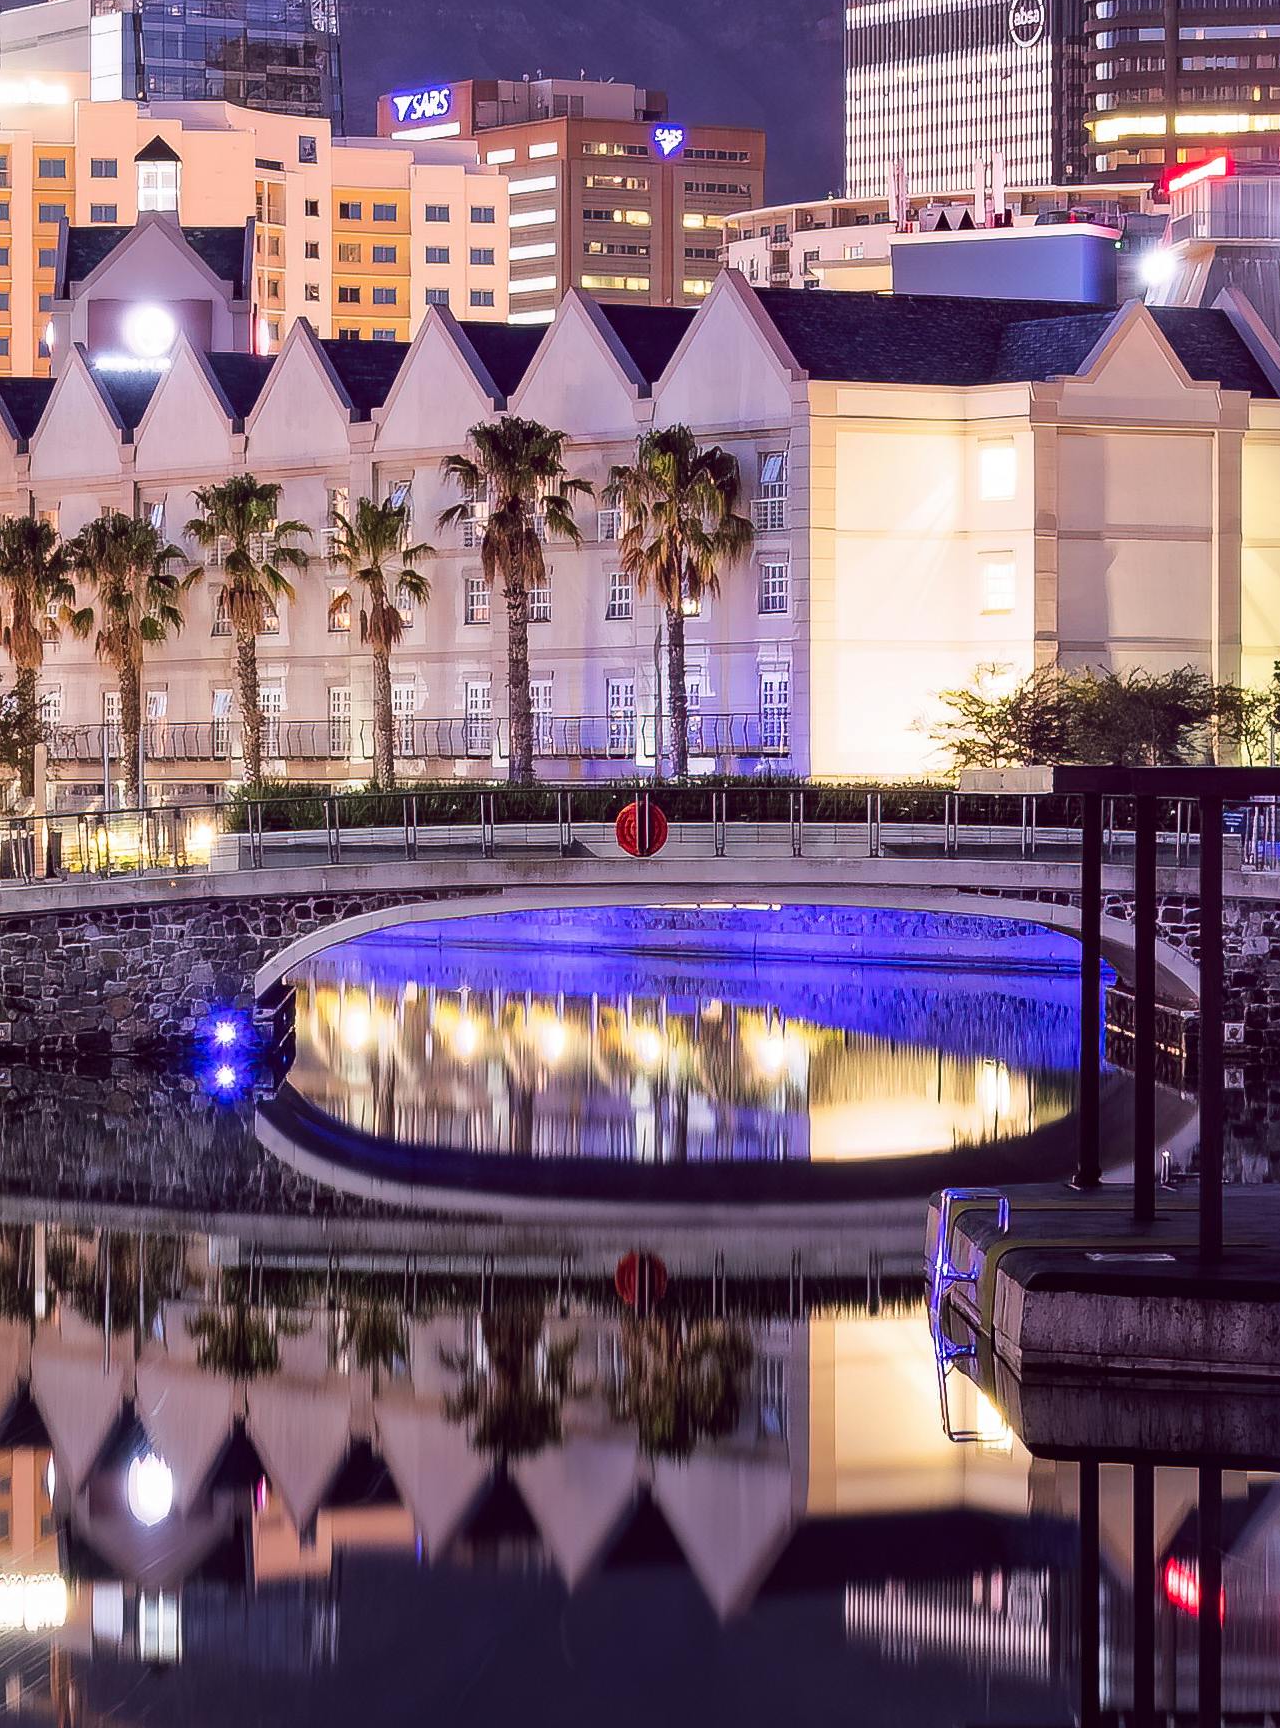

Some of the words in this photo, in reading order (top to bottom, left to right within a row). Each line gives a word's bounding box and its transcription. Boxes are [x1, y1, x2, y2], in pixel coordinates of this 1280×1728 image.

[1014, 6, 1040, 26] absa
[411, 88, 450, 120] SARS
[654, 128, 683, 142] SARS
